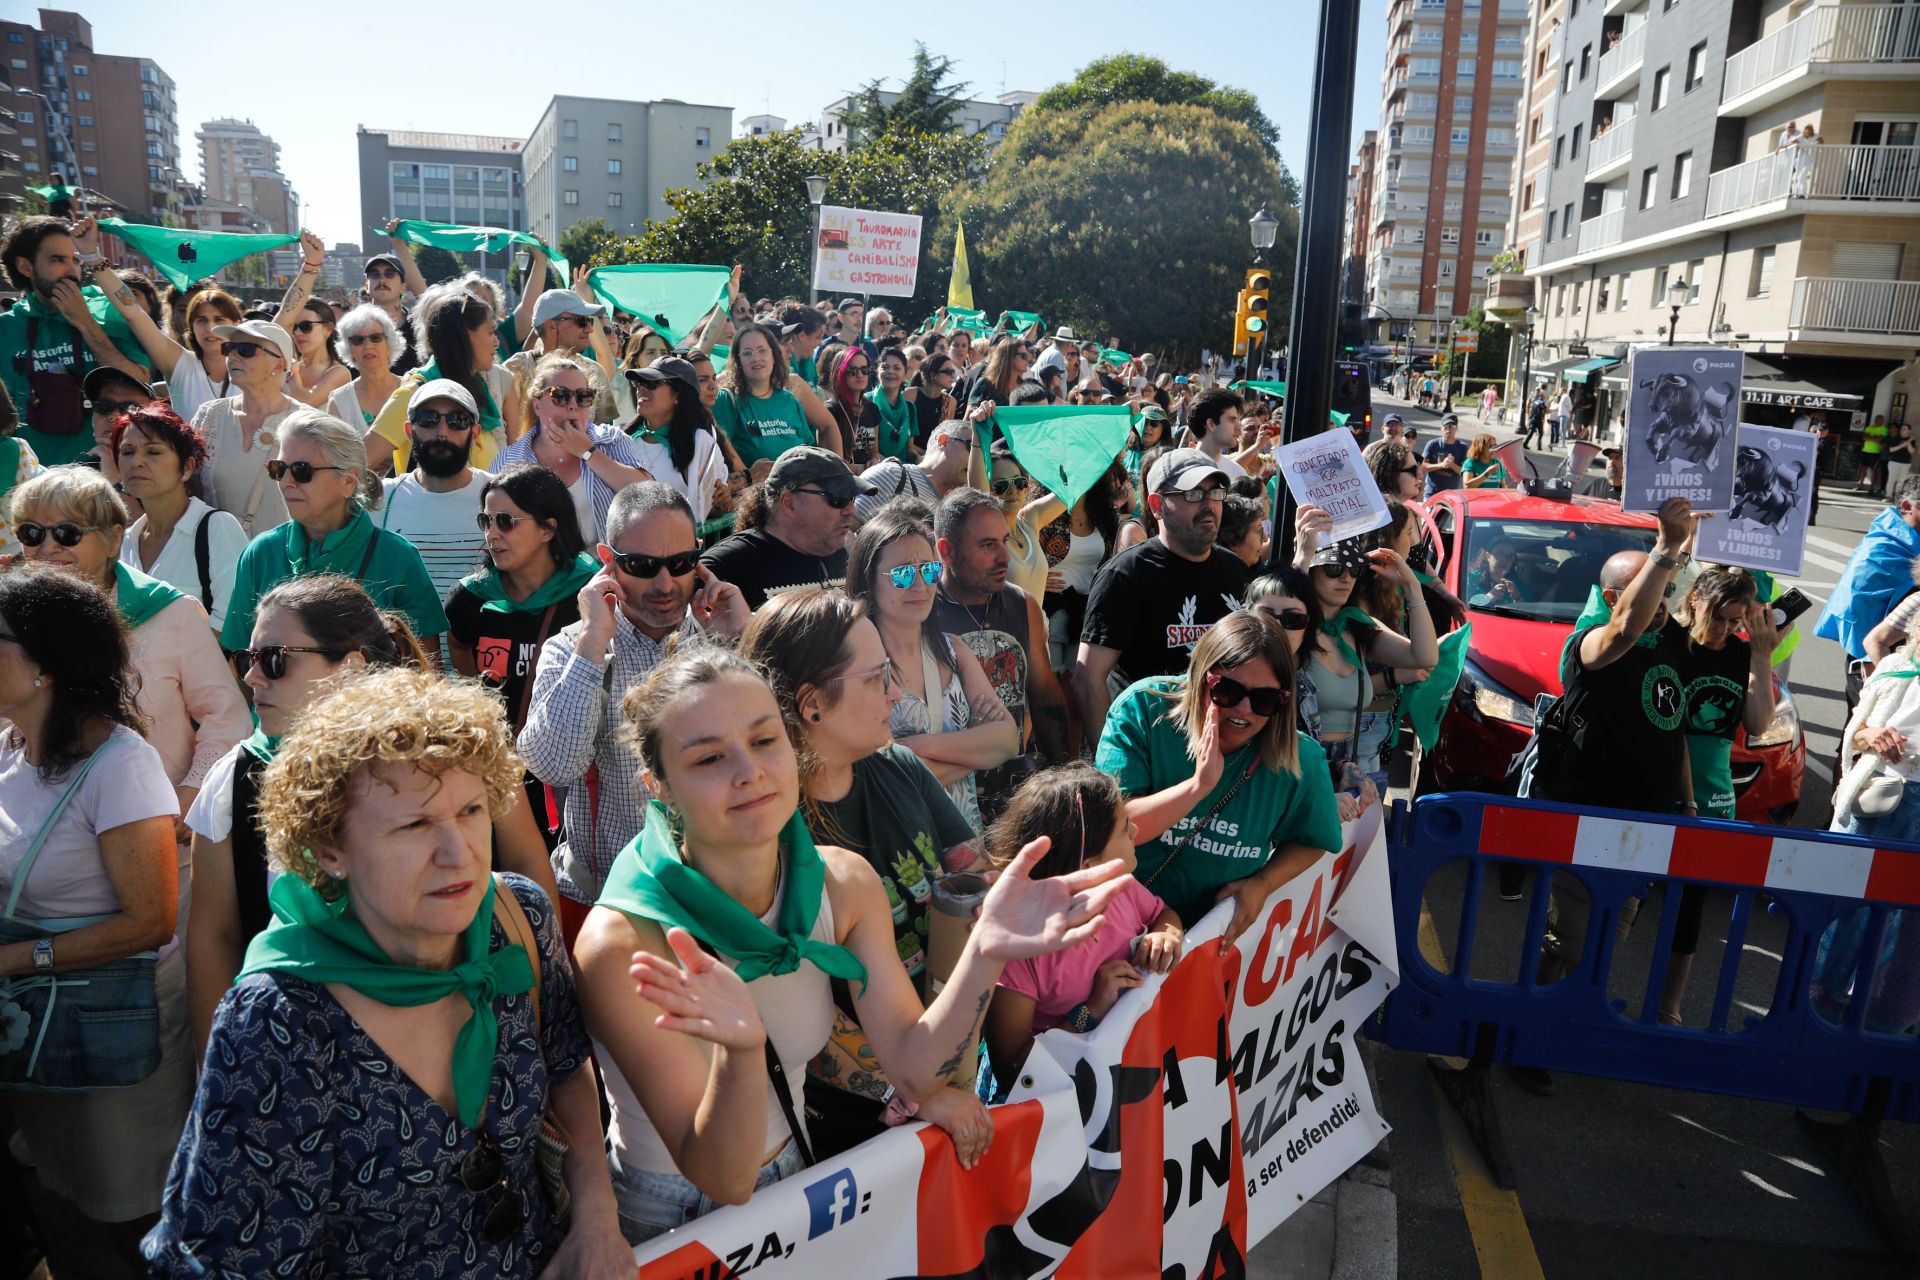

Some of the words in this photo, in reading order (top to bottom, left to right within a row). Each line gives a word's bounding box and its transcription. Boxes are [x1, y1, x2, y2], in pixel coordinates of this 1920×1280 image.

[872, 238, 903, 251] ARTE
[1746, 391, 1773, 403] 11.11
[1776, 394, 1801, 405] ART
[1803, 396, 1834, 408] CAFE
[1292, 448, 1350, 475] CANCELADA
[1320, 468, 1339, 481] POR
[1305, 478, 1361, 503] MALTRATO
[1645, 488, 1656, 502] Y
[1718, 540, 1729, 553] Y
[1727, 542, 1782, 561] LIBRES!
[1247, 1180, 1257, 1198] a
[1260, 1154, 1283, 1188] ser
